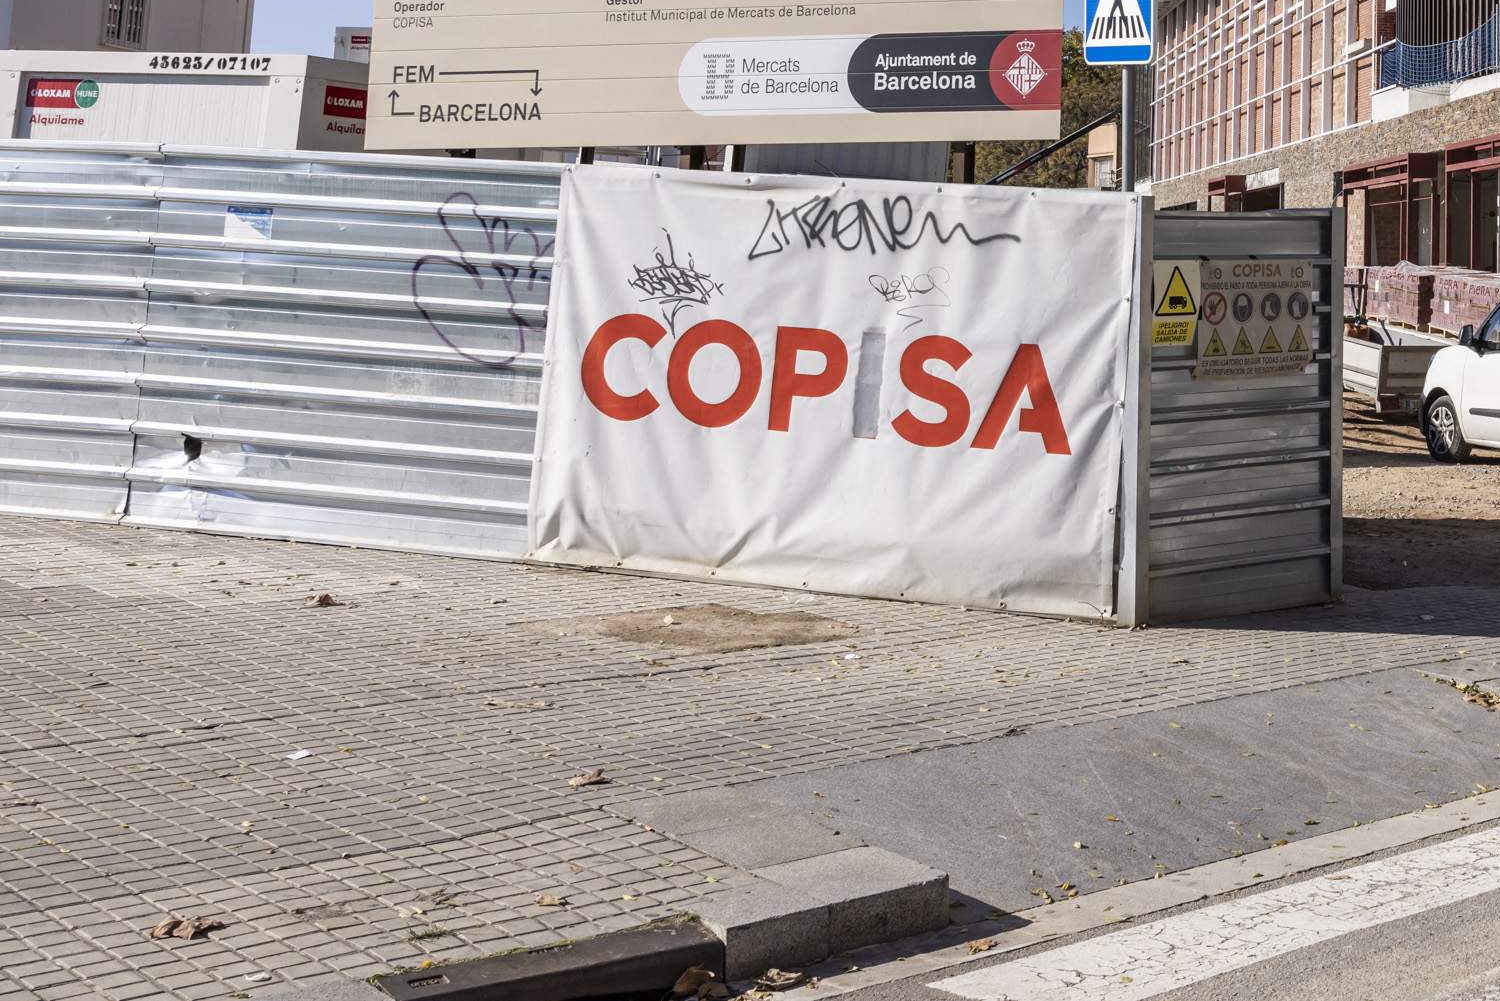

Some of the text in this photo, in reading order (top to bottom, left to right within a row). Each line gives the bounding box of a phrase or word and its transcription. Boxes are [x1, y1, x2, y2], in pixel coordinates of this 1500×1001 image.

[394, 1, 445, 16] Operador
[606, 5, 856, 23] Institut Municipal de Mercats de Barcelona
[393, 16, 434, 29] COPISA
[742, 57, 801, 74] Mercats
[875, 52, 977, 71] Ajuntament de
[393, 65, 435, 83] FEM
[873, 71, 976, 92] Barcelona
[37, 88, 71, 98] LOXAM
[76, 89, 98, 98] HUNE
[740, 77, 839, 95] de Barcelona
[334, 97, 364, 109] LOXAM
[29, 114, 85, 126] Alquilame
[418, 102, 542, 125] BARCELONA
[1232, 264, 1282, 278] COPISA
[581, 313, 1072, 456] COPISA
